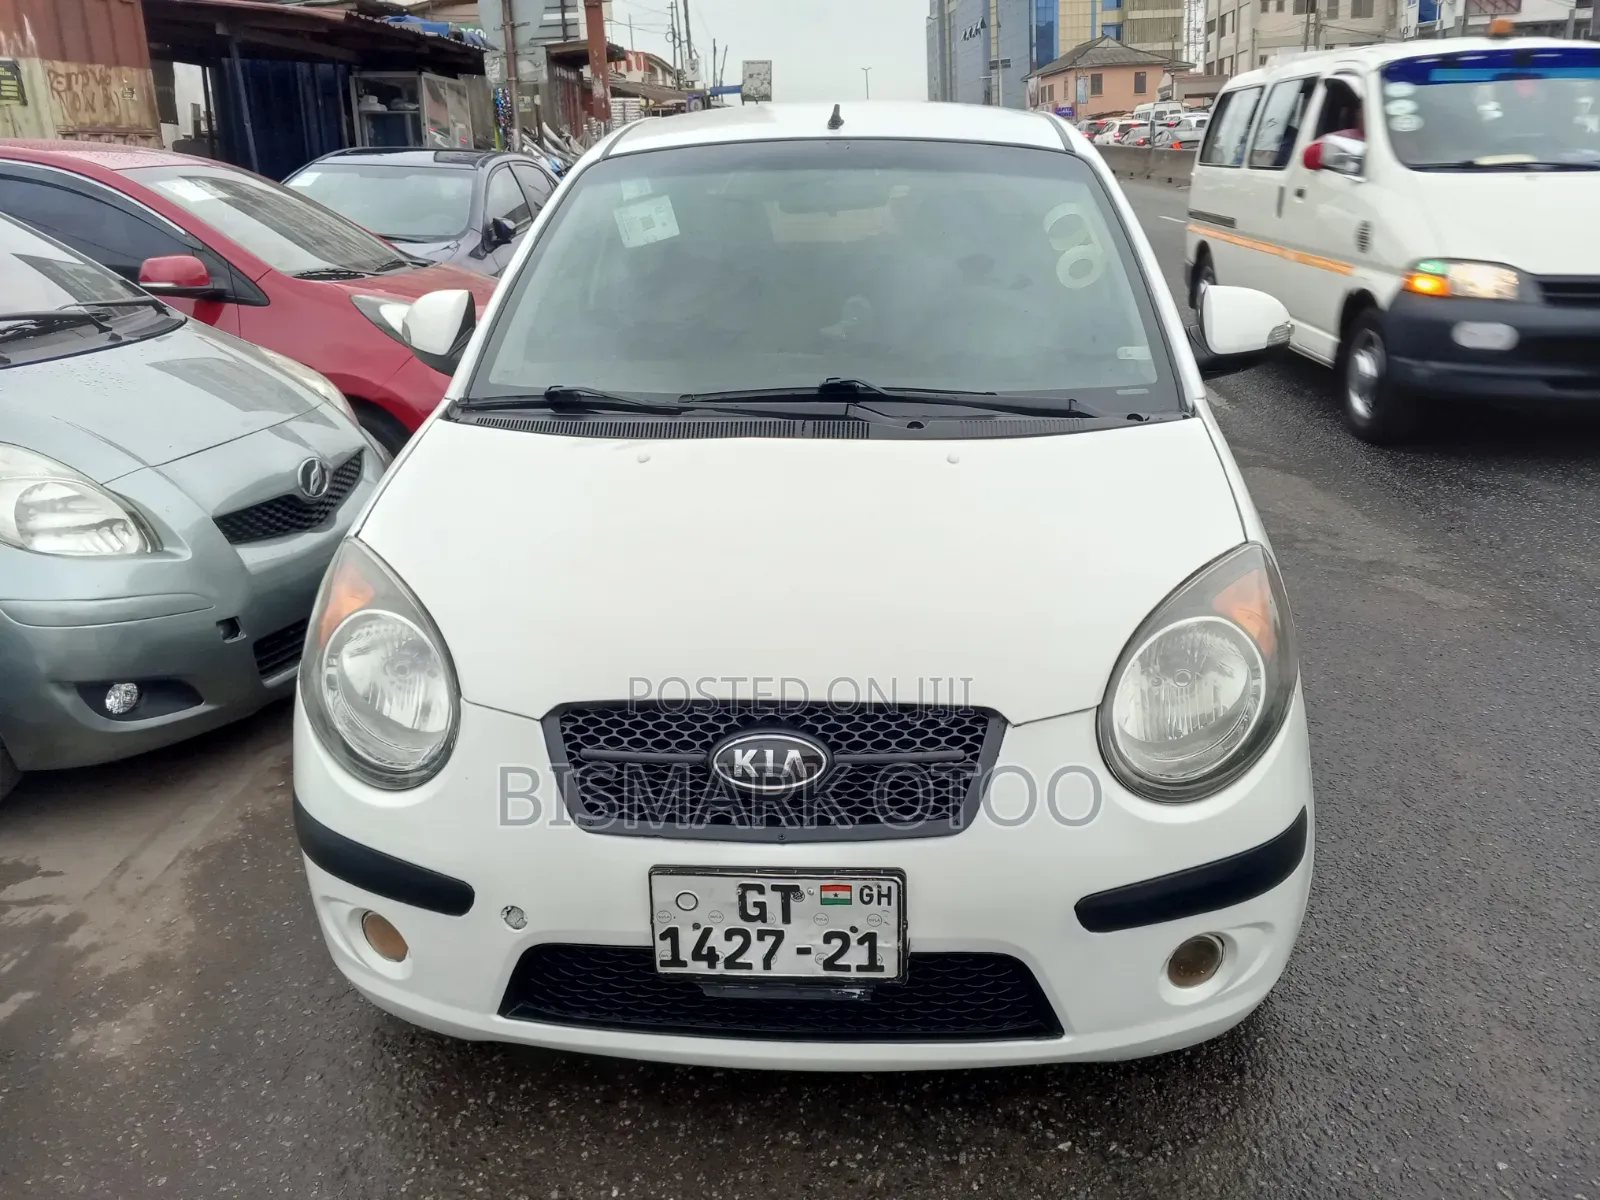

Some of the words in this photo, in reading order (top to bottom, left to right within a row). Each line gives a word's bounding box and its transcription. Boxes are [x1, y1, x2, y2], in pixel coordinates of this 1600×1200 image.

[733, 749, 808, 778] KIA
[738, 883, 801, 925] GT
[859, 885, 892, 906] GH
[659, 926, 885, 973] 1427-21
